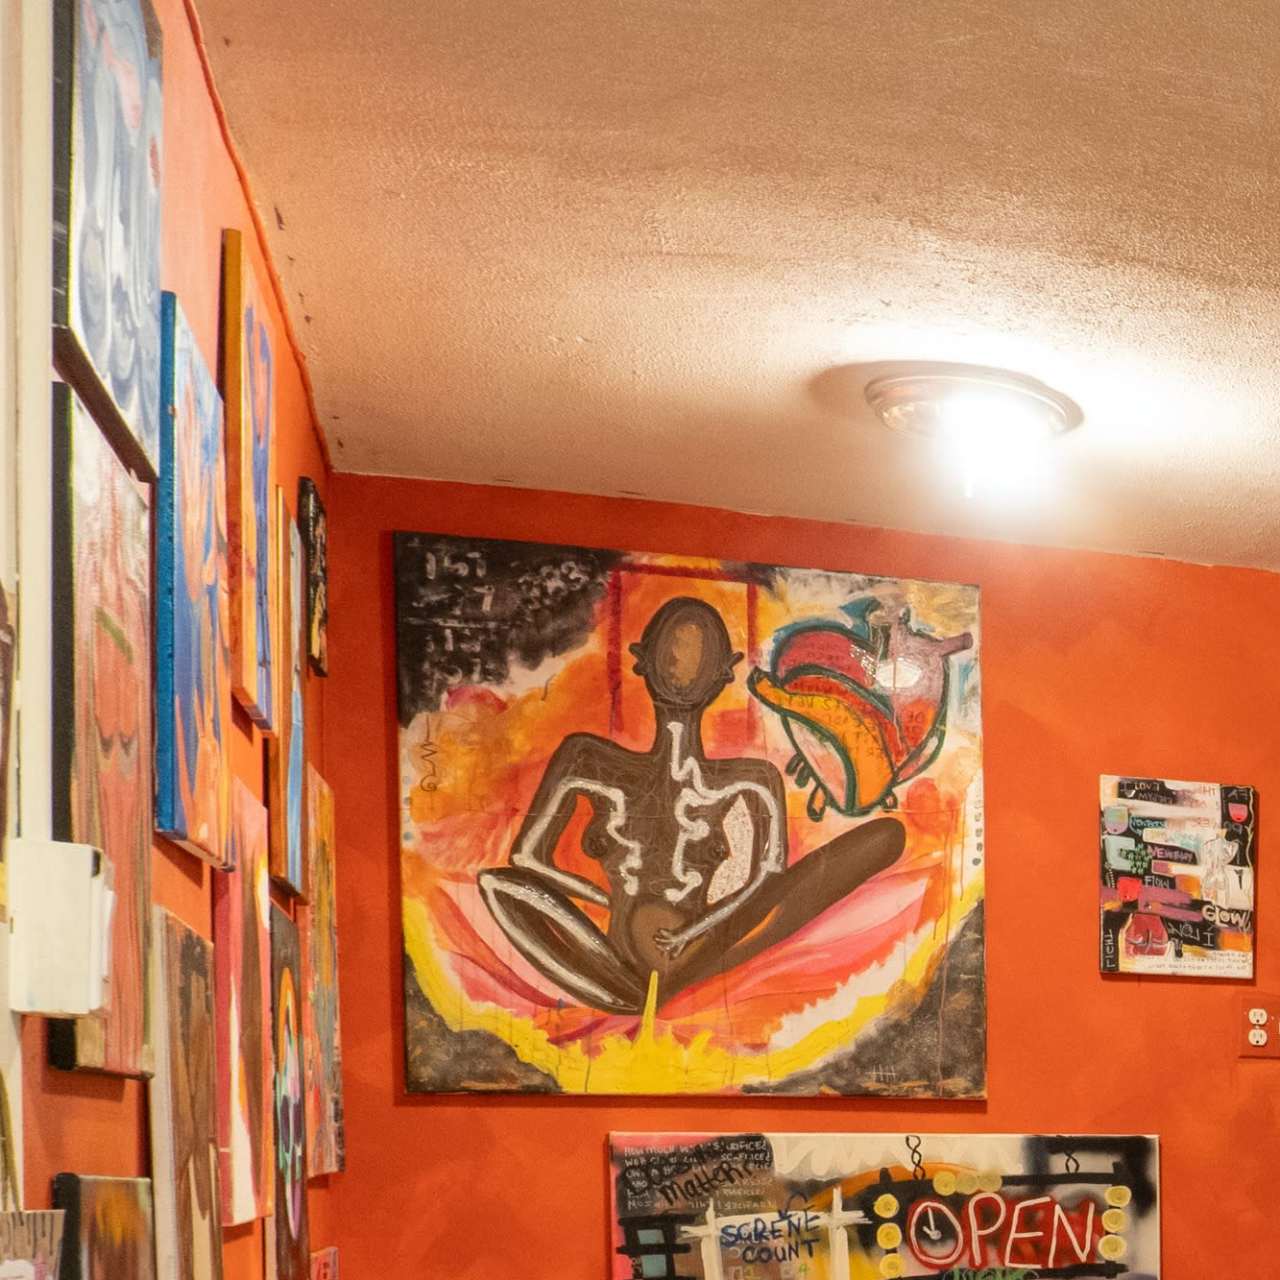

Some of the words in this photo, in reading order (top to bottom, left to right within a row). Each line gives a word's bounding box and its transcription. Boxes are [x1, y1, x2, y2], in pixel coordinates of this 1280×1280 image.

[1202, 904, 1249, 928] GLOW
[910, 1192, 1095, 1268] OPEN
[742, 1239, 820, 1263] COUNT
